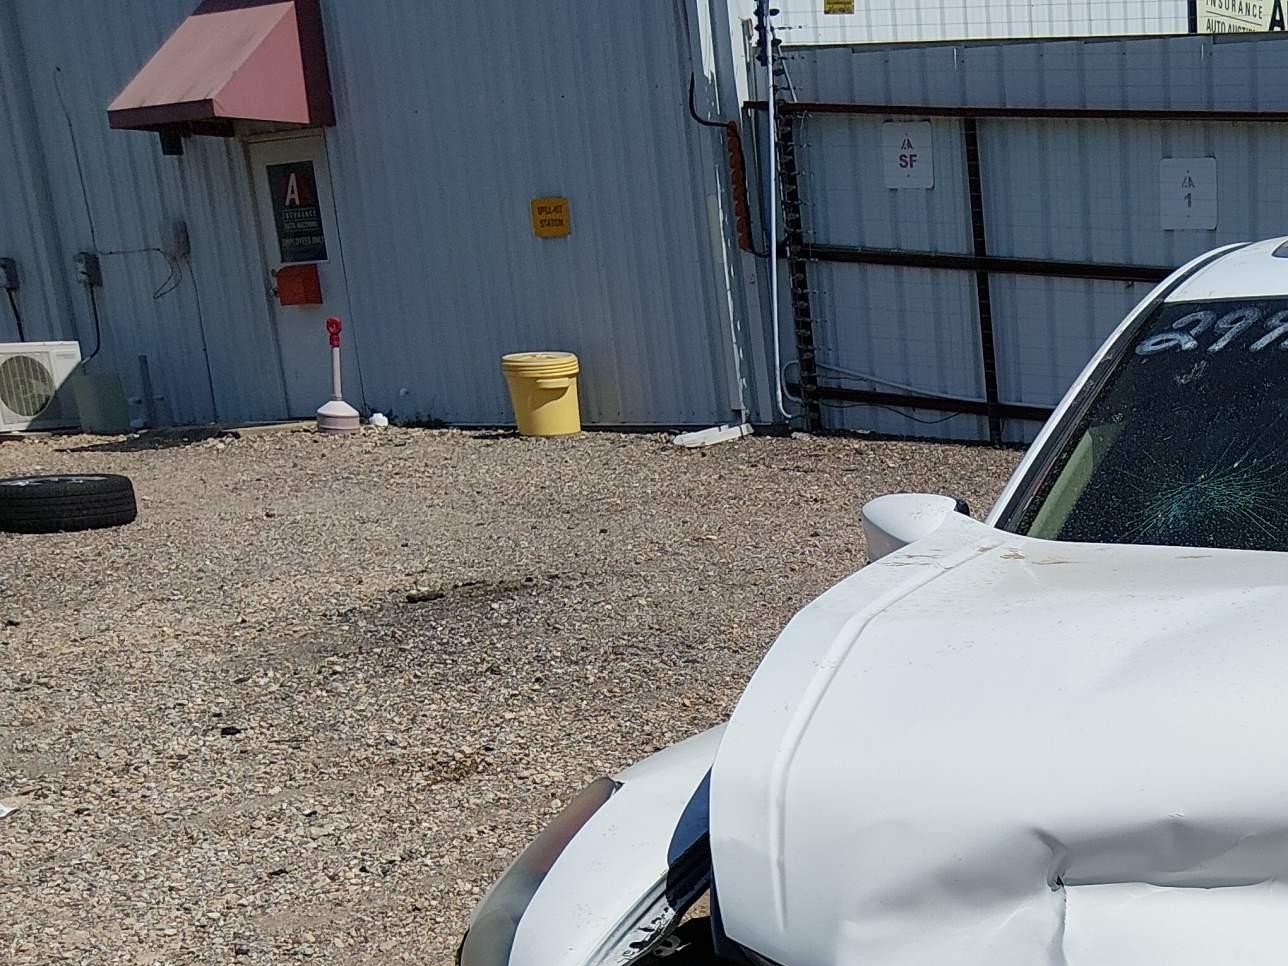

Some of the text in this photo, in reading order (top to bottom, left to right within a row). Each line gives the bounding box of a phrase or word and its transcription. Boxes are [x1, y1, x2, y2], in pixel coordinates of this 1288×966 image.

[1207, 18, 1225, 33] AUTO
[899, 154, 917, 168] SF
[1184, 193, 1192, 208] 1
